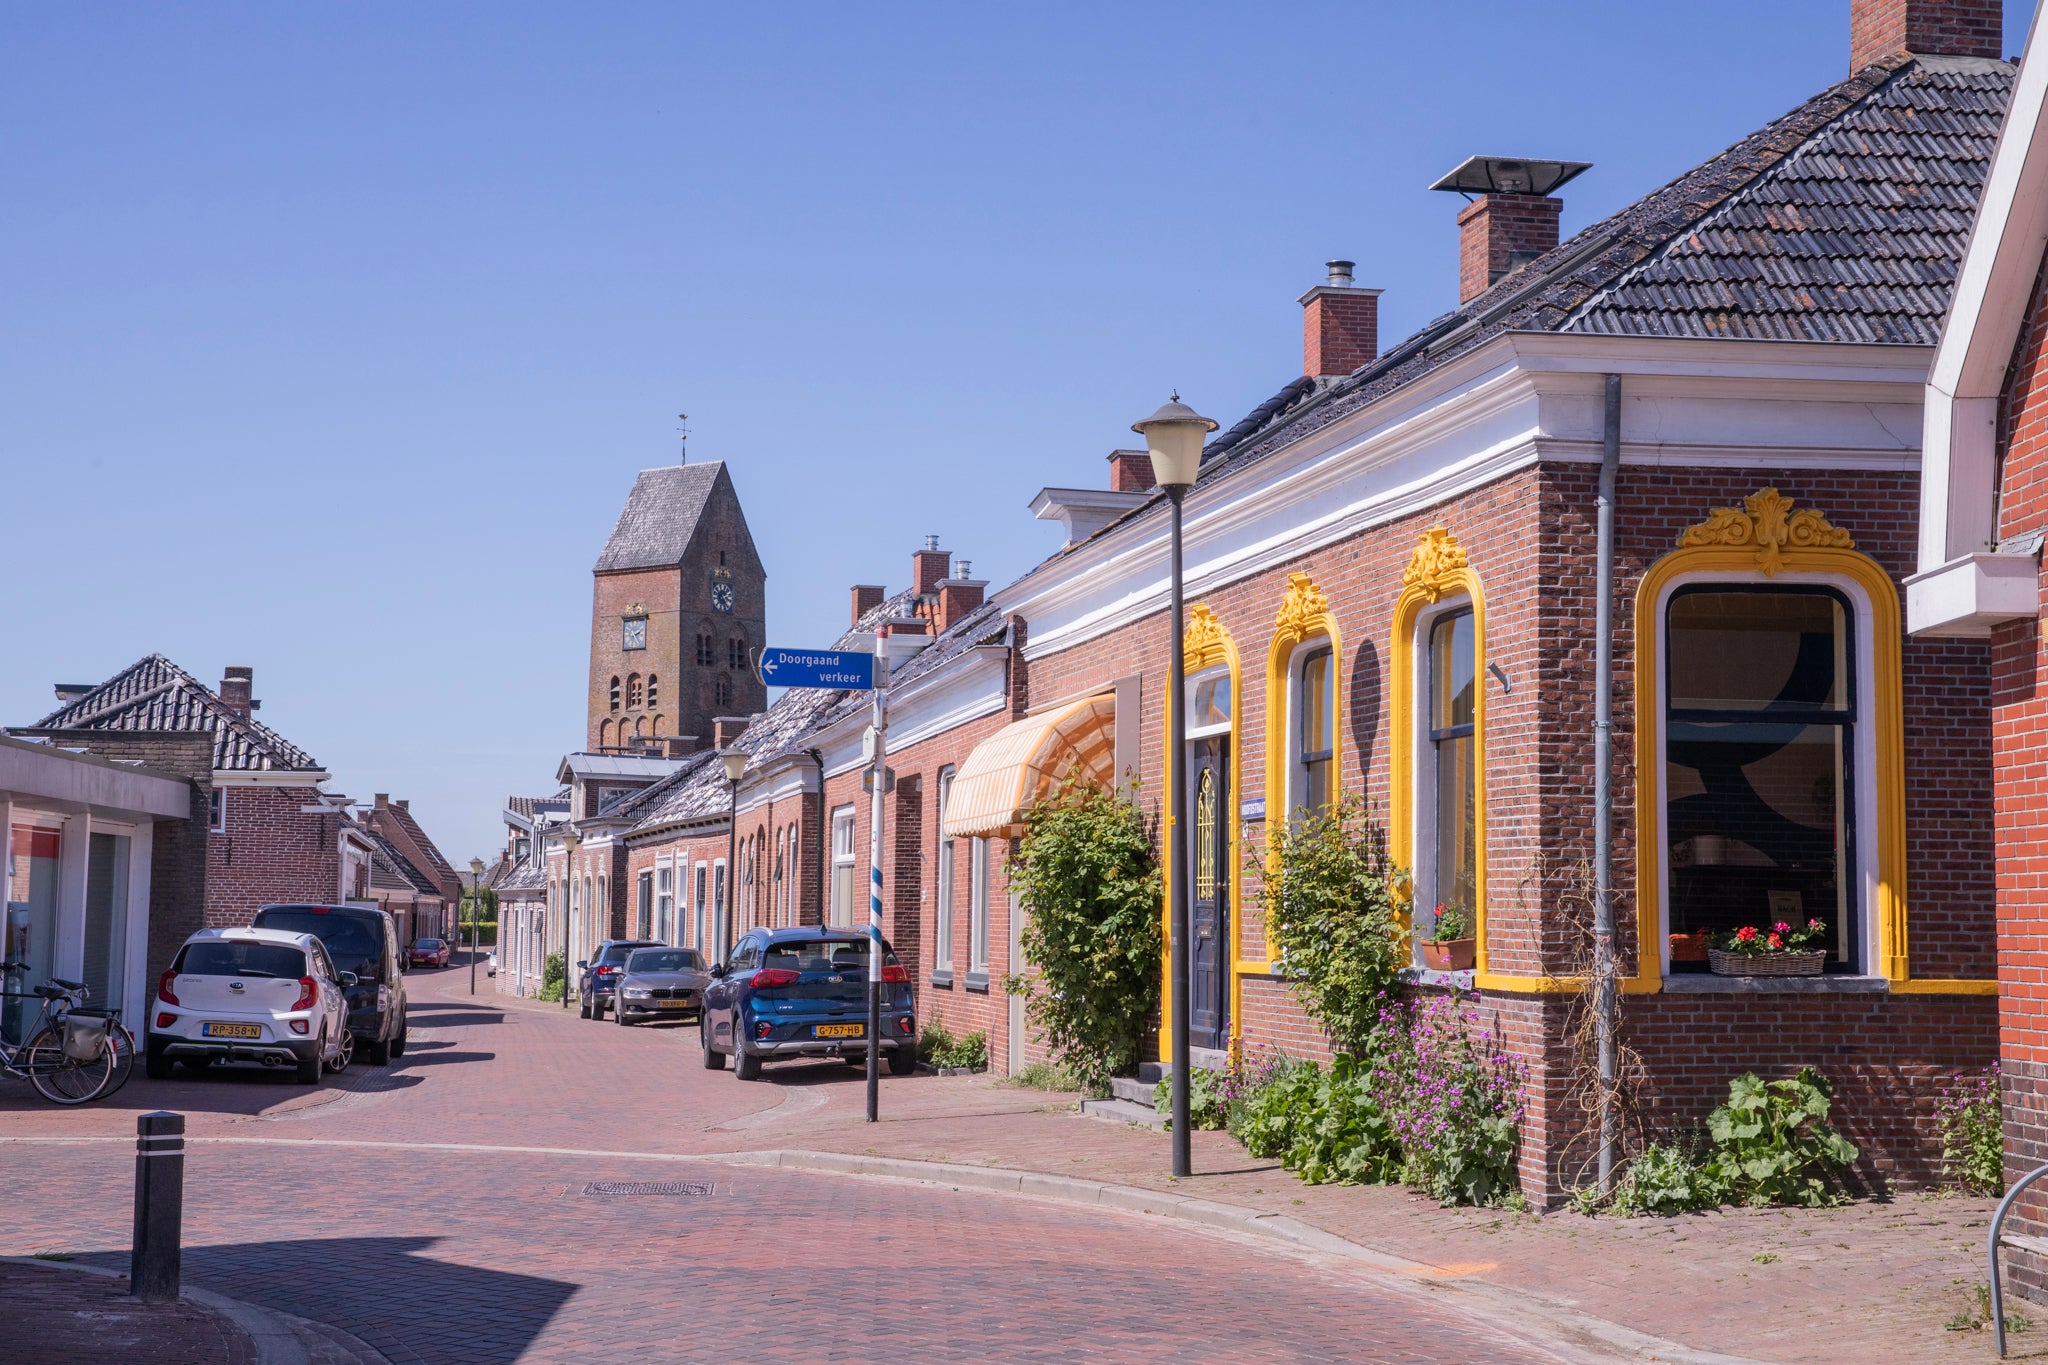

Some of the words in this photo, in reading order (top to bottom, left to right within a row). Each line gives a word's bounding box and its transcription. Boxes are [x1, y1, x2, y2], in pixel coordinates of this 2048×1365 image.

[779, 653, 839, 667] Doorgaand
[819, 672, 861, 683] verkeer
[212, 1025, 258, 1036] RP-358-N
[819, 1026, 860, 1034] G-757-HB
